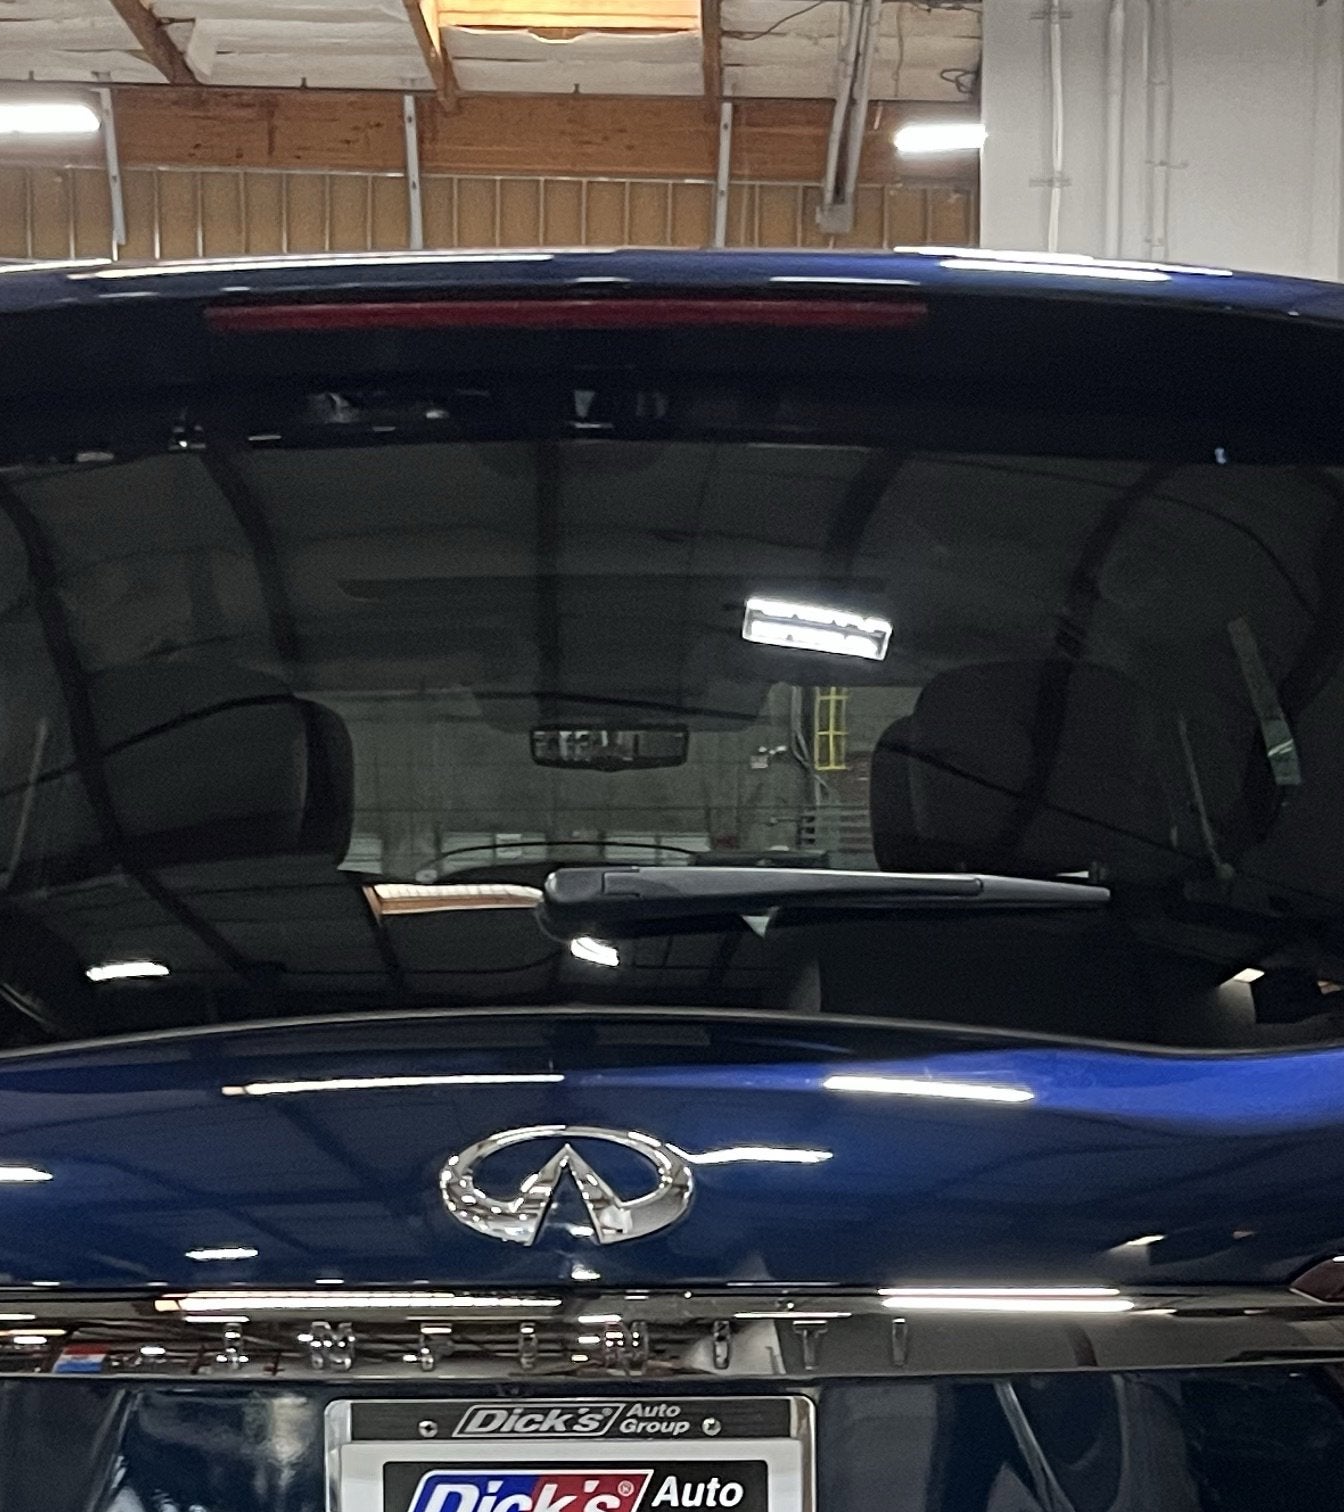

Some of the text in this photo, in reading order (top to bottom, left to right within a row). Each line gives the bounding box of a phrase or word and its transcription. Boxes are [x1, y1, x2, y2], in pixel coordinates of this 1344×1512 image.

[626, 1402, 681, 1419] Auto
[619, 1417, 690, 1436] Group
[651, 1476, 744, 1509] Auto
